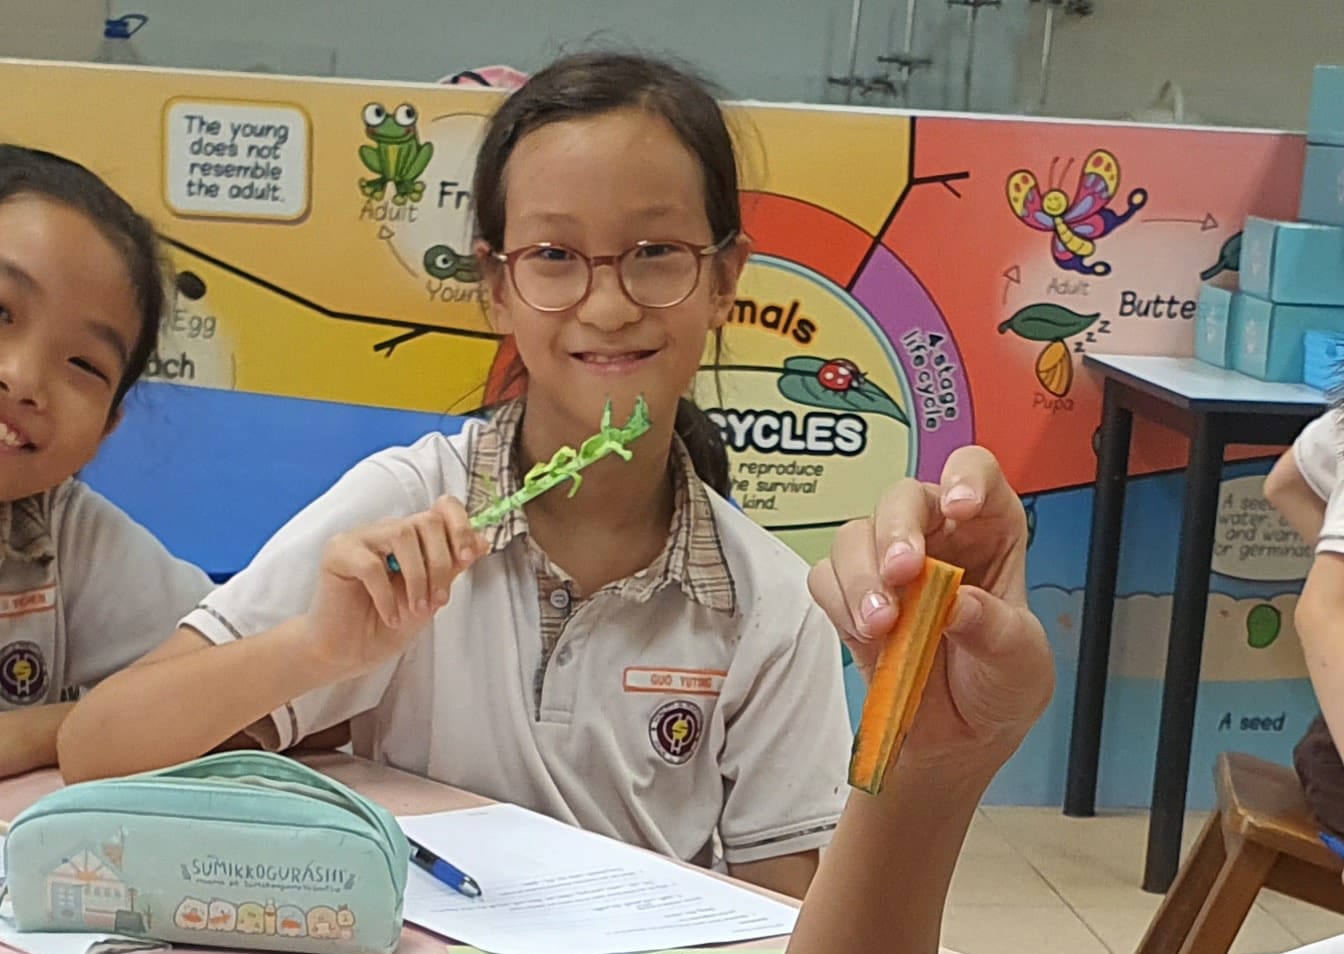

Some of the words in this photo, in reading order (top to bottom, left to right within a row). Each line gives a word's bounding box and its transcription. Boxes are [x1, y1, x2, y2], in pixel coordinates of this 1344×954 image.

[185, 115, 221, 135] The
[230, 122, 289, 144] young
[190, 137, 238, 157] does
[246, 144, 281, 160] not
[189, 162, 282, 180] resemble
[187, 178, 220, 198] the
[359, 200, 418, 223] Adult
[1046, 278, 1090, 296] Adult
[1119, 291, 1196, 319] Butte
[173, 309, 216, 338] Egg
[934, 354, 956, 418] stage
[1032, 393, 1074, 415] Pupa
[739, 462, 824, 480] reproduce
[757, 480, 817, 494] survival
[1217, 712, 1232, 732] A
[1240, 712, 1286, 732] seed
